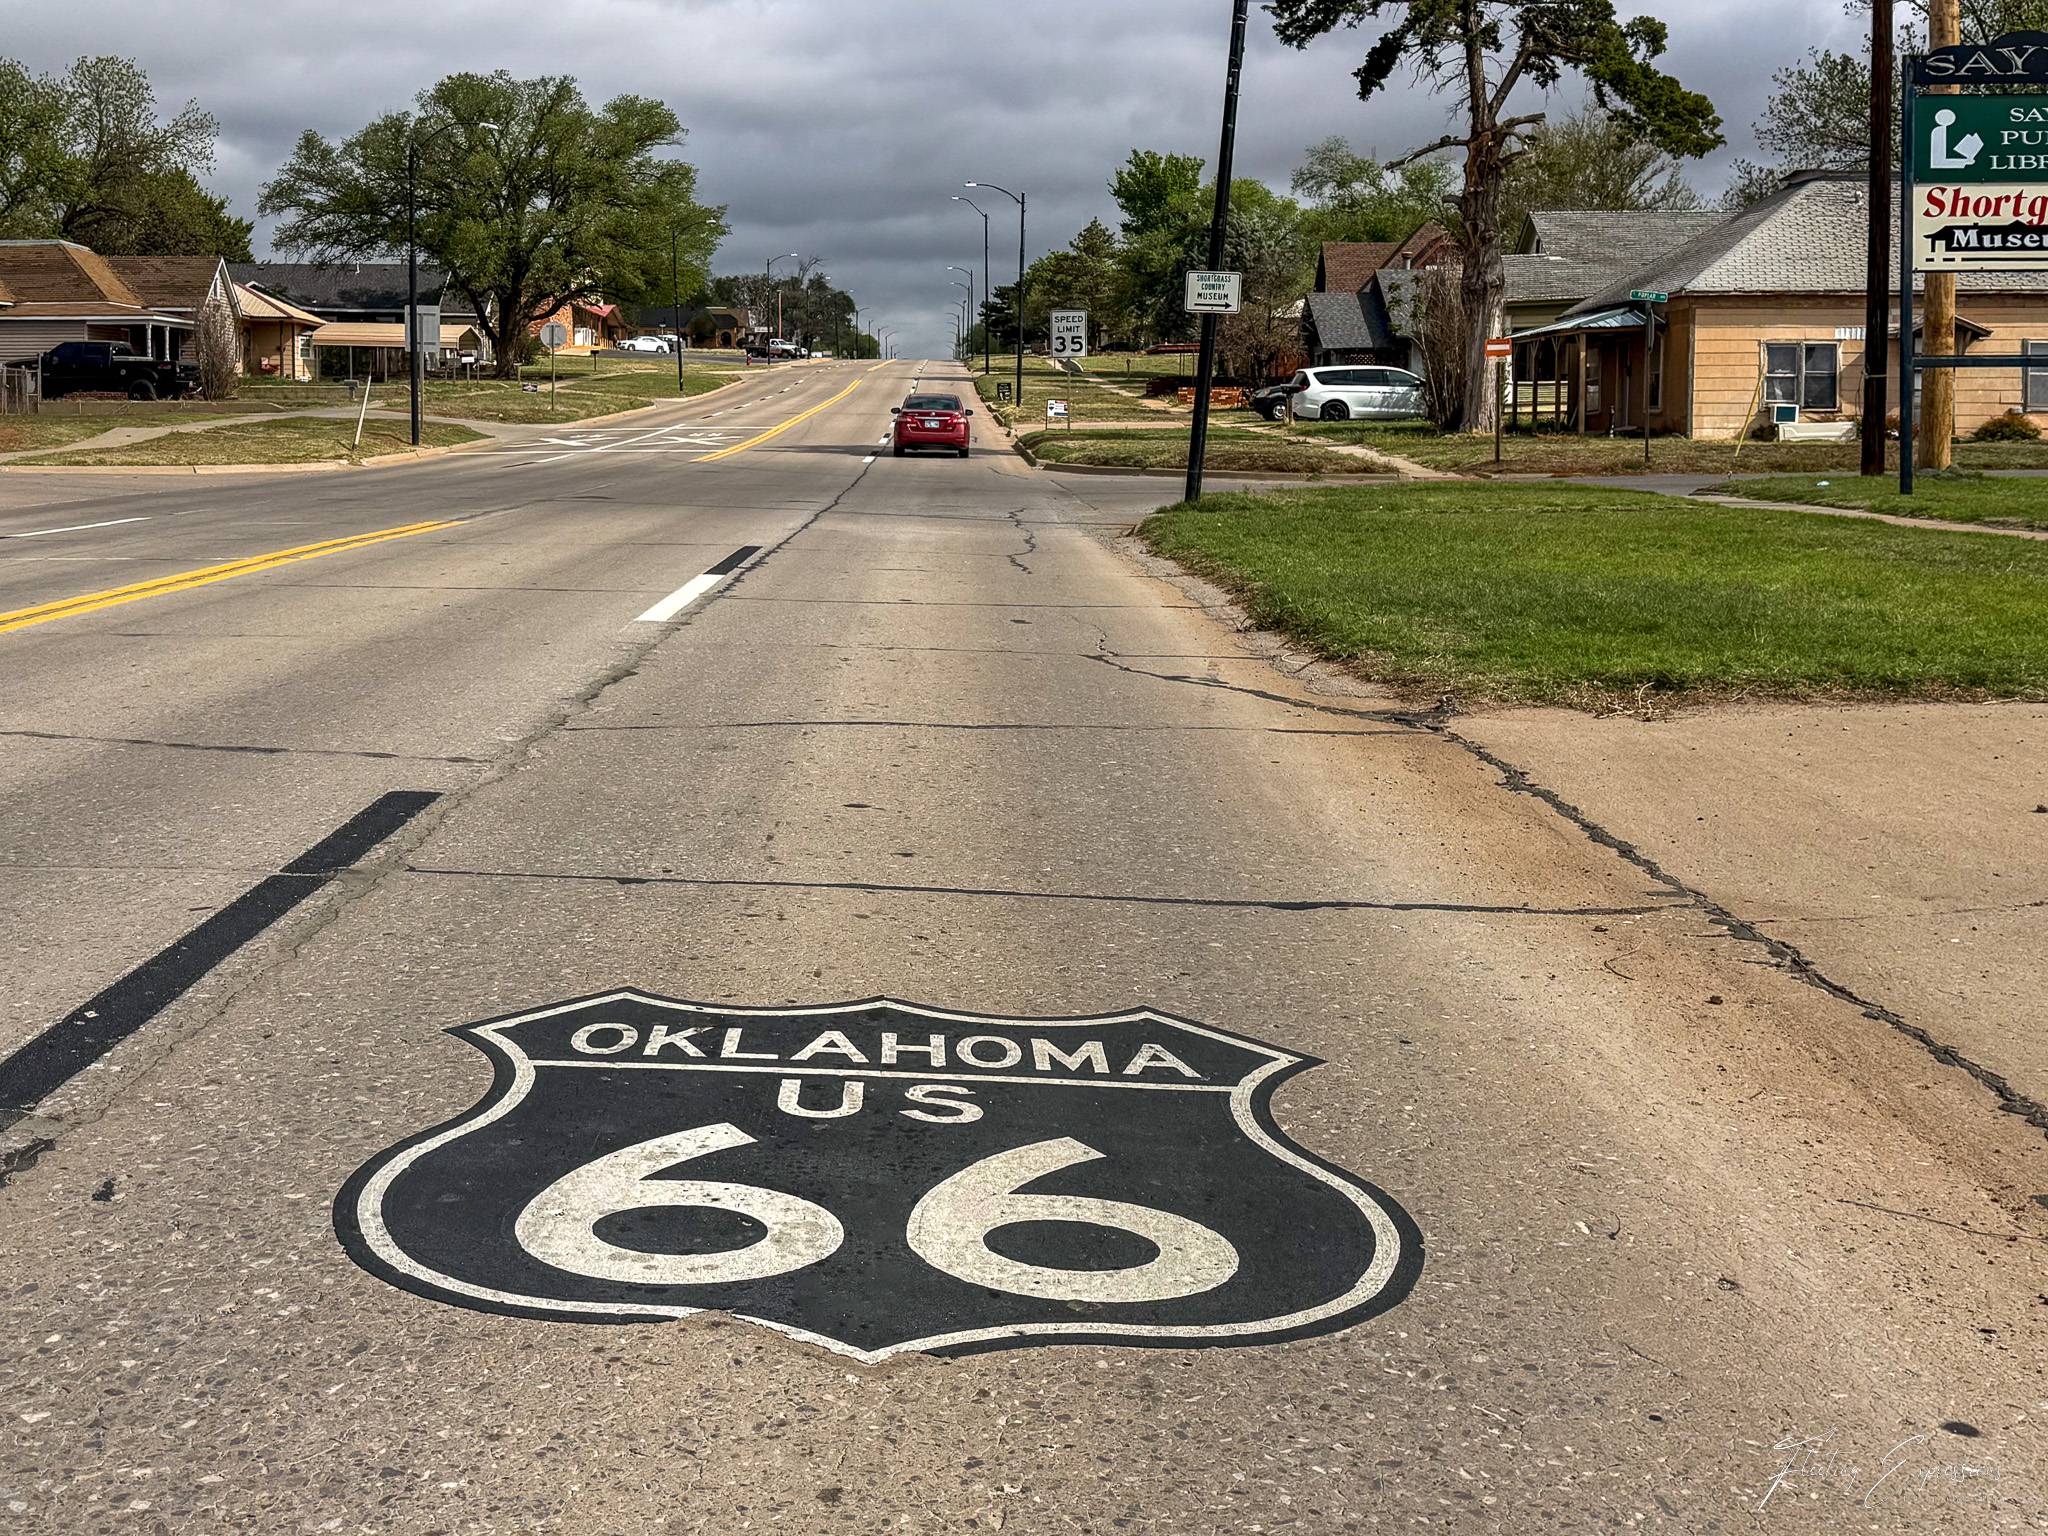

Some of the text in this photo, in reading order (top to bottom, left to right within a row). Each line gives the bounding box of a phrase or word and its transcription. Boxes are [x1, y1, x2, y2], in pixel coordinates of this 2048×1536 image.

[1925, 45, 2048, 76] SAY
[2000, 130, 2048, 145] PU
[1196, 274, 1231, 283] SHORTGRASS
[1201, 283, 1226, 291] COUNTRY
[1197, 292, 1229, 300] MUSEUM
[1054, 315, 1084, 323] SPEED
[1054, 336, 1084, 353] 35
[570, 1022, 1204, 1079] OKLAHOMA
[514, 1122, 1240, 1303] 66
